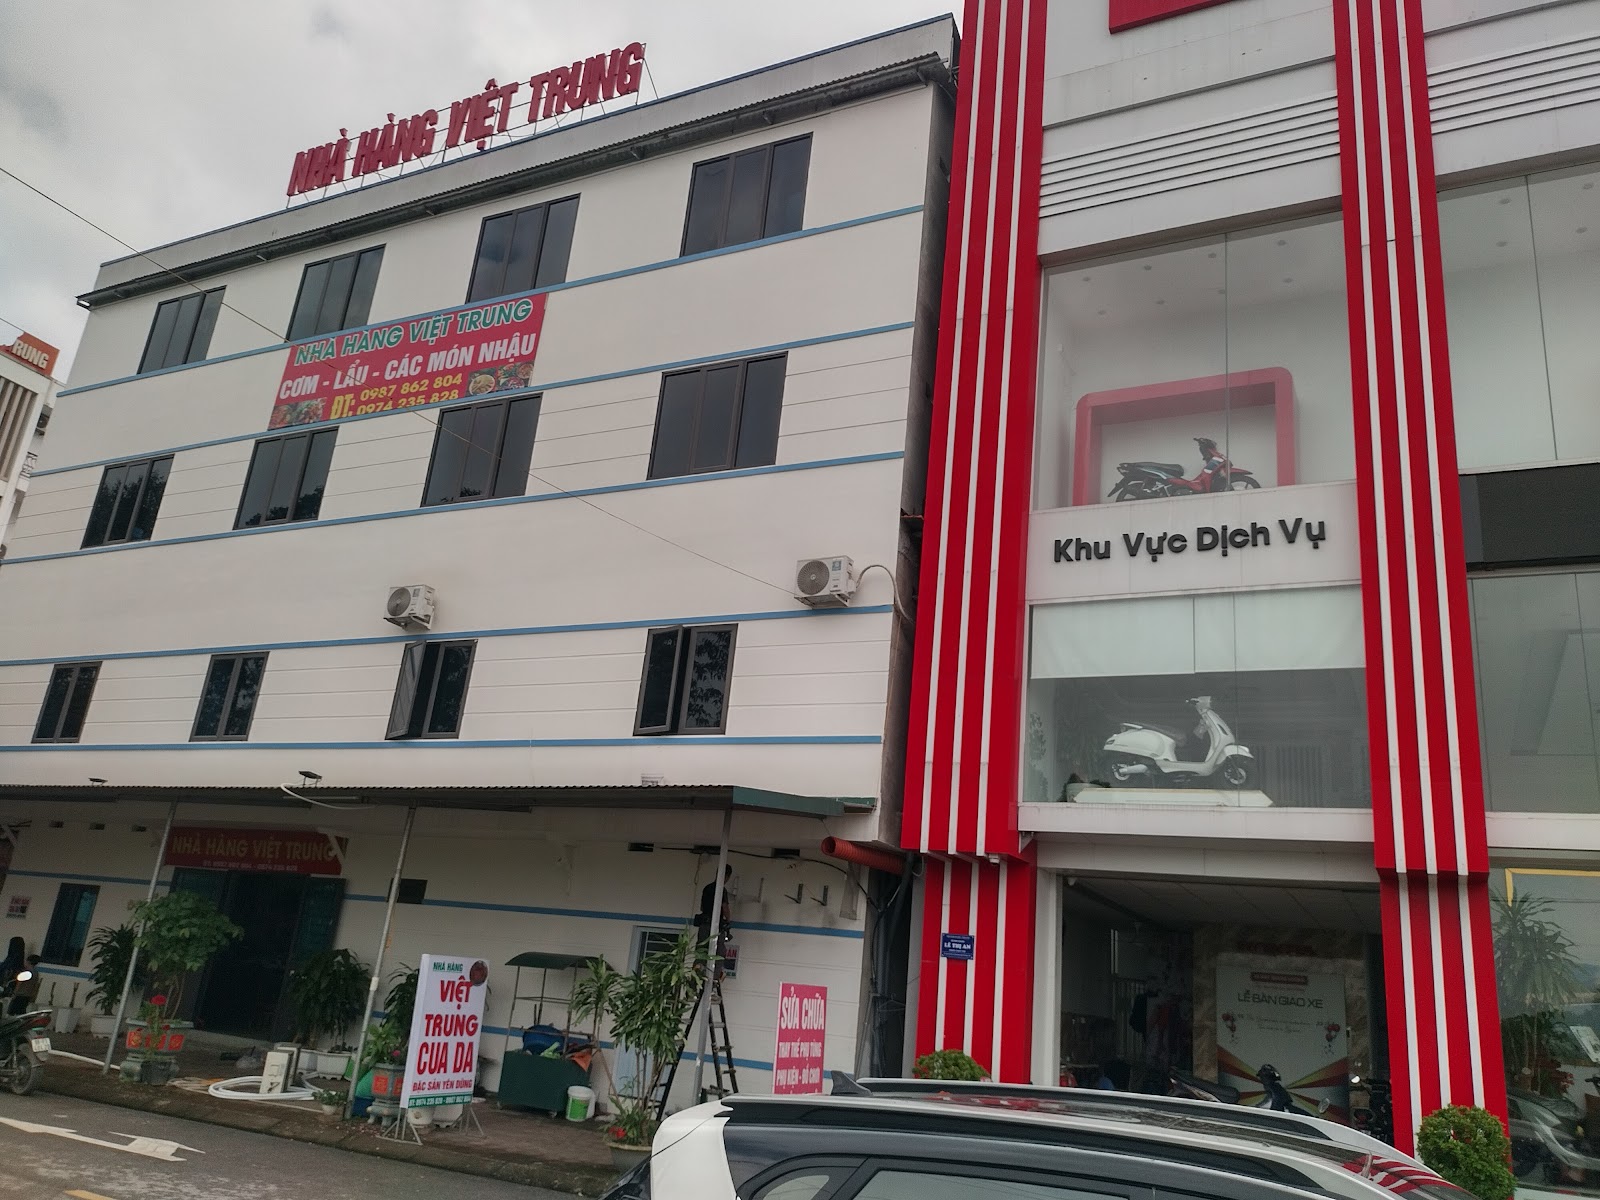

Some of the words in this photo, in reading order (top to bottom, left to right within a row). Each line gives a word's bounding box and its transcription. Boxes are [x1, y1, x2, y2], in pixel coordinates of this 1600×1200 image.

[286, 128, 350, 197] NHÀ
[352, 113, 439, 178] HÀNG
[446, 78, 520, 151] VIỆT
[527, 42, 645, 124] TRUNG
[294, 335, 338, 366] NHÀ
[341, 326, 404, 356] HÀNG
[409, 314, 454, 346] VIỆT
[457, 299, 533, 334] TRUNG
[279, 374, 319, 400] CƠM
[333, 358, 369, 391] LẨU
[384, 354, 424, 381] CÁC
[427, 344, 472, 373] MÓN
[477, 333, 537, 364] NHẬU
[357, 400, 393, 415] 0974
[397, 395, 425, 408] 235
[429, 389, 459, 403] 828
[360, 384, 397, 401] 0987
[400, 379, 429, 395] 862
[433, 373, 463, 389] 804
[1054, 537, 1111, 562] Khu
[1122, 531, 1188, 562] Vực
[1196, 522, 1270, 557] Dịch
[1278, 517, 1326, 549] Vụ
[172, 832, 201, 855] NHÀ
[206, 834, 249, 858] HÀNG
[252, 836, 281, 863] VIỆT
[286, 840, 337, 862] TRUNG
[433, 962, 446, 972] NHÀ
[447, 961, 463, 972] HÀNG
[440, 975, 473, 1010] VIỆT
[781, 986, 800, 1030] SỬA
[802, 993, 824, 1030] CHỮA
[1252, 992, 1276, 1005] BÀN
[1278, 995, 1305, 1007] GIAO
[1307, 998, 1325, 1009] XE
[425, 1014, 479, 1037] TRUNG
[417, 1042, 449, 1075] CUA
[453, 1042, 474, 1073] DA
